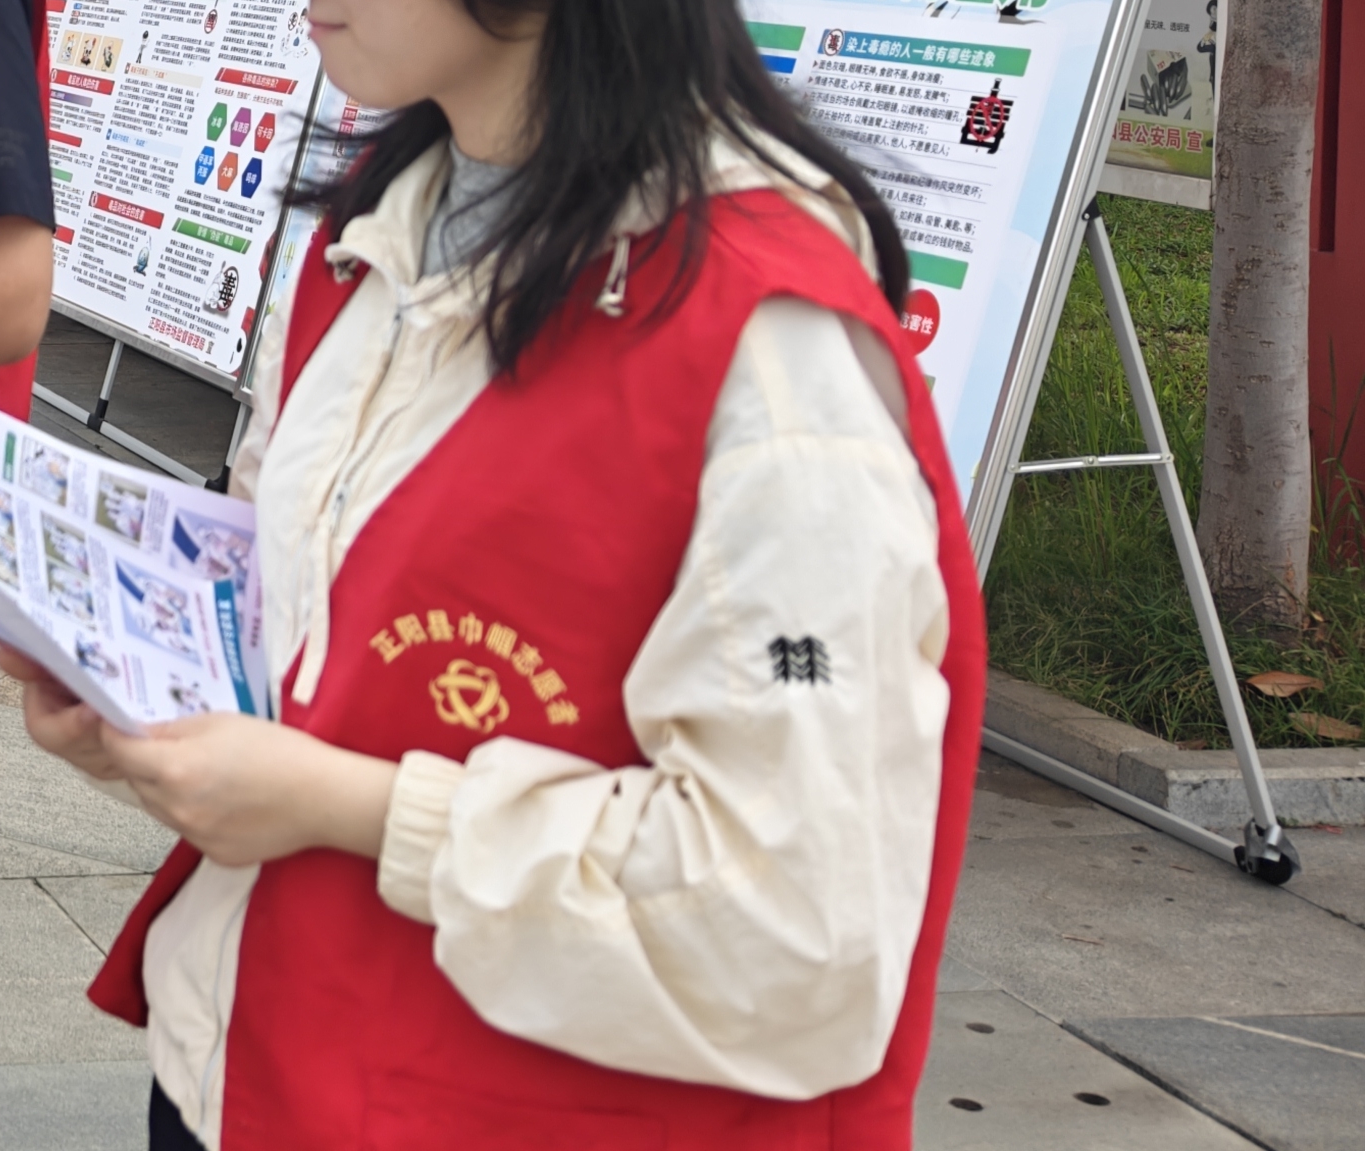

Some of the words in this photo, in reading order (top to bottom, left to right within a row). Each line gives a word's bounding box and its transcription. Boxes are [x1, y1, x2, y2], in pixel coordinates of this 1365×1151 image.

[845, 36, 995, 68] 染上毒瘾的人一般有哪些迹象
[1186, 130, 1203, 152] 宣
